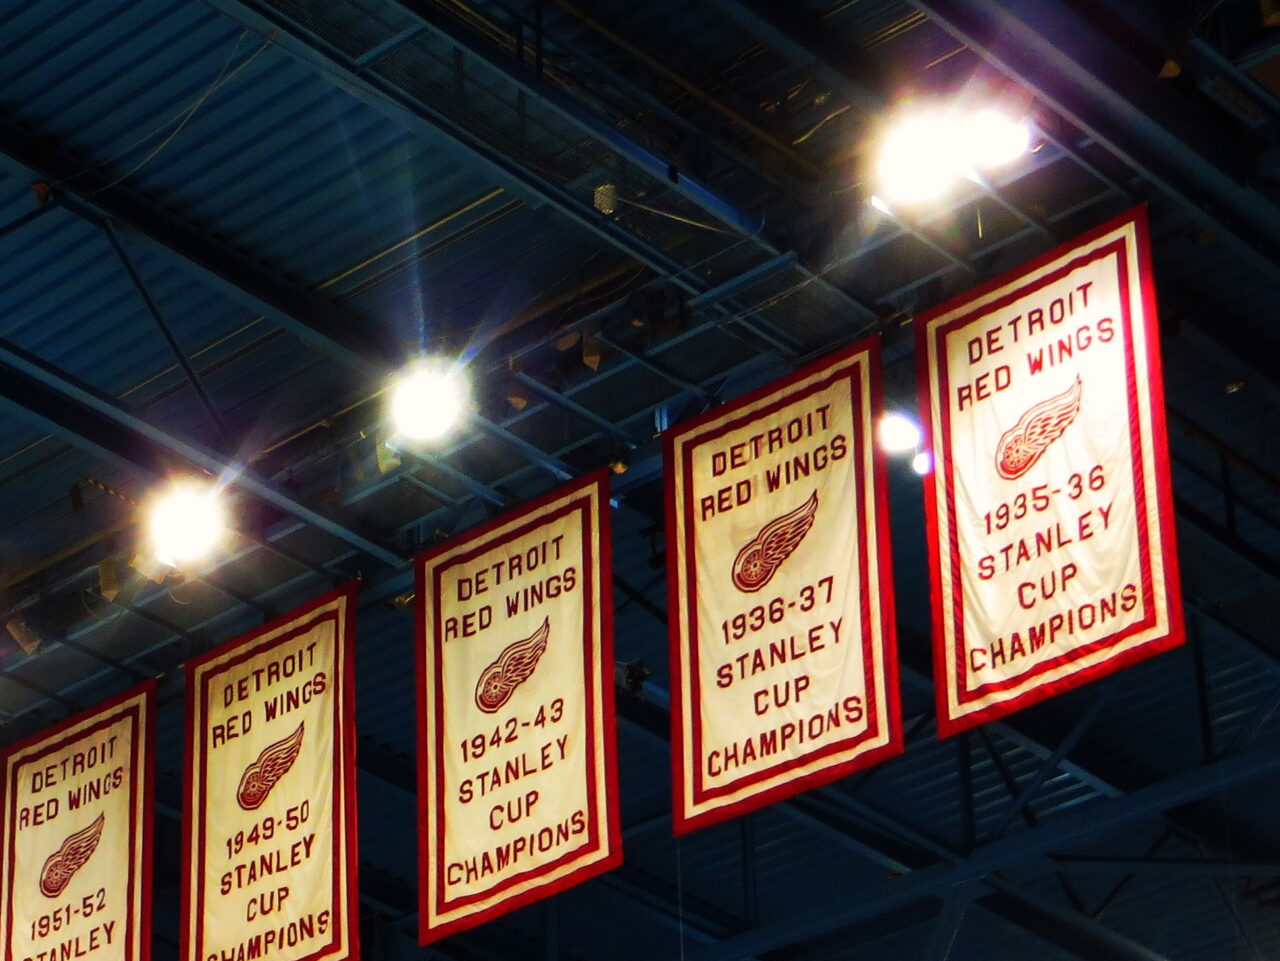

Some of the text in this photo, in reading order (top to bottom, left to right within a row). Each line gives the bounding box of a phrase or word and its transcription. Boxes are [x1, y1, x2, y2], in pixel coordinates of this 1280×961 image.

[967, 281, 1093, 366] DETROIT
[957, 317, 1115, 412] RED WINGS
[711, 404, 831, 477] DETROIT
[700, 434, 847, 522] RED WINGS
[984, 465, 1105, 535] 1935-36
[457, 534, 564, 602] DETROIT
[977, 503, 1113, 580] STANLEY
[444, 566, 576, 642] RED WINGS
[722, 575, 834, 645] 1936-37
[1017, 563, 1078, 610] CUP
[716, 616, 843, 689] STANLEY
[969, 583, 1137, 674] CHAMPIONS
[211, 672, 327, 749] RED WINGS
[223, 642, 317, 709] DETROIT
[754, 675, 810, 717] CUP
[31, 735, 118, 795] DETROIT
[460, 698, 564, 763] 1942-43
[706, 695, 863, 778] CHAMPIONS
[19, 766, 123, 831] RED WINGS
[458, 734, 569, 804] STANLEY
[225, 799, 310, 861] 1949-50
[489, 790, 539, 831] CUP
[220, 833, 315, 896] STANLEY
[447, 810, 586, 887] CHAMPIONS
[31, 887, 106, 941] 1951-52
[246, 886, 289, 922] CUP
